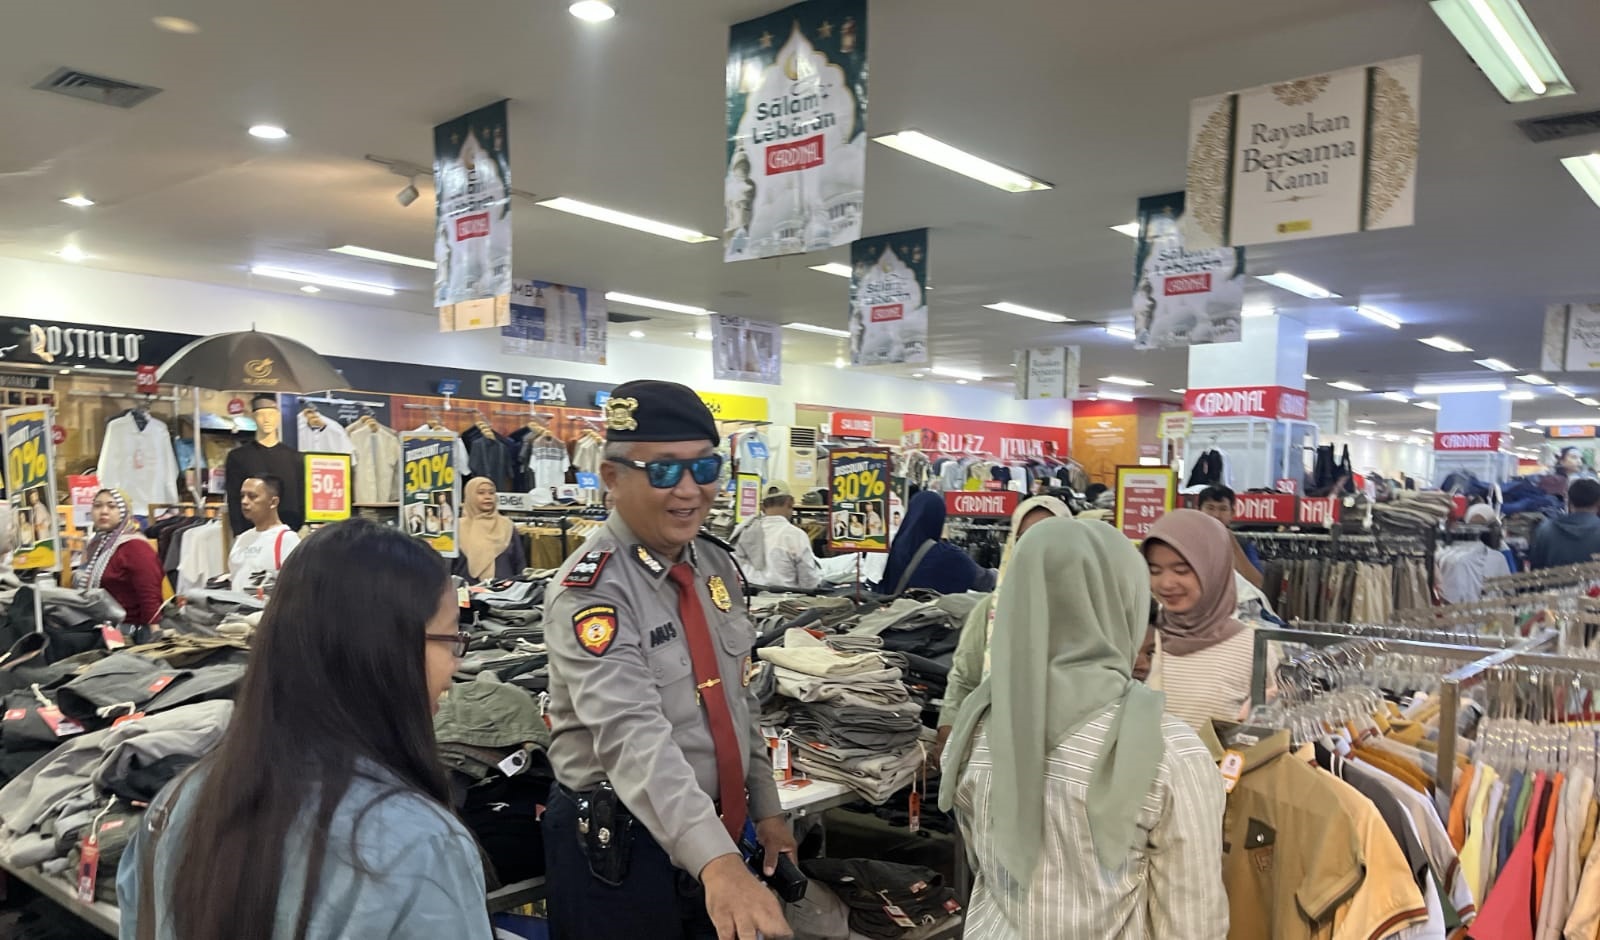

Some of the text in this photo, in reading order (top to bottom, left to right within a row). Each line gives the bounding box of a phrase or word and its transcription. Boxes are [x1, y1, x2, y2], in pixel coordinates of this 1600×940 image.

[1250, 112, 1350, 149] Rayakan
[768, 142, 822, 169] CARDINAL
[1240, 140, 1356, 172] Bersama
[1264, 164, 1329, 192] Kami
[510, 283, 544, 297] MBA
[1195, 390, 1267, 413] CARDINAL
[406, 453, 454, 492] 30%
[832, 469, 885, 502] 30%
[955, 496, 1005, 514] CARDINAL
[1236, 498, 1279, 519] DINAL
